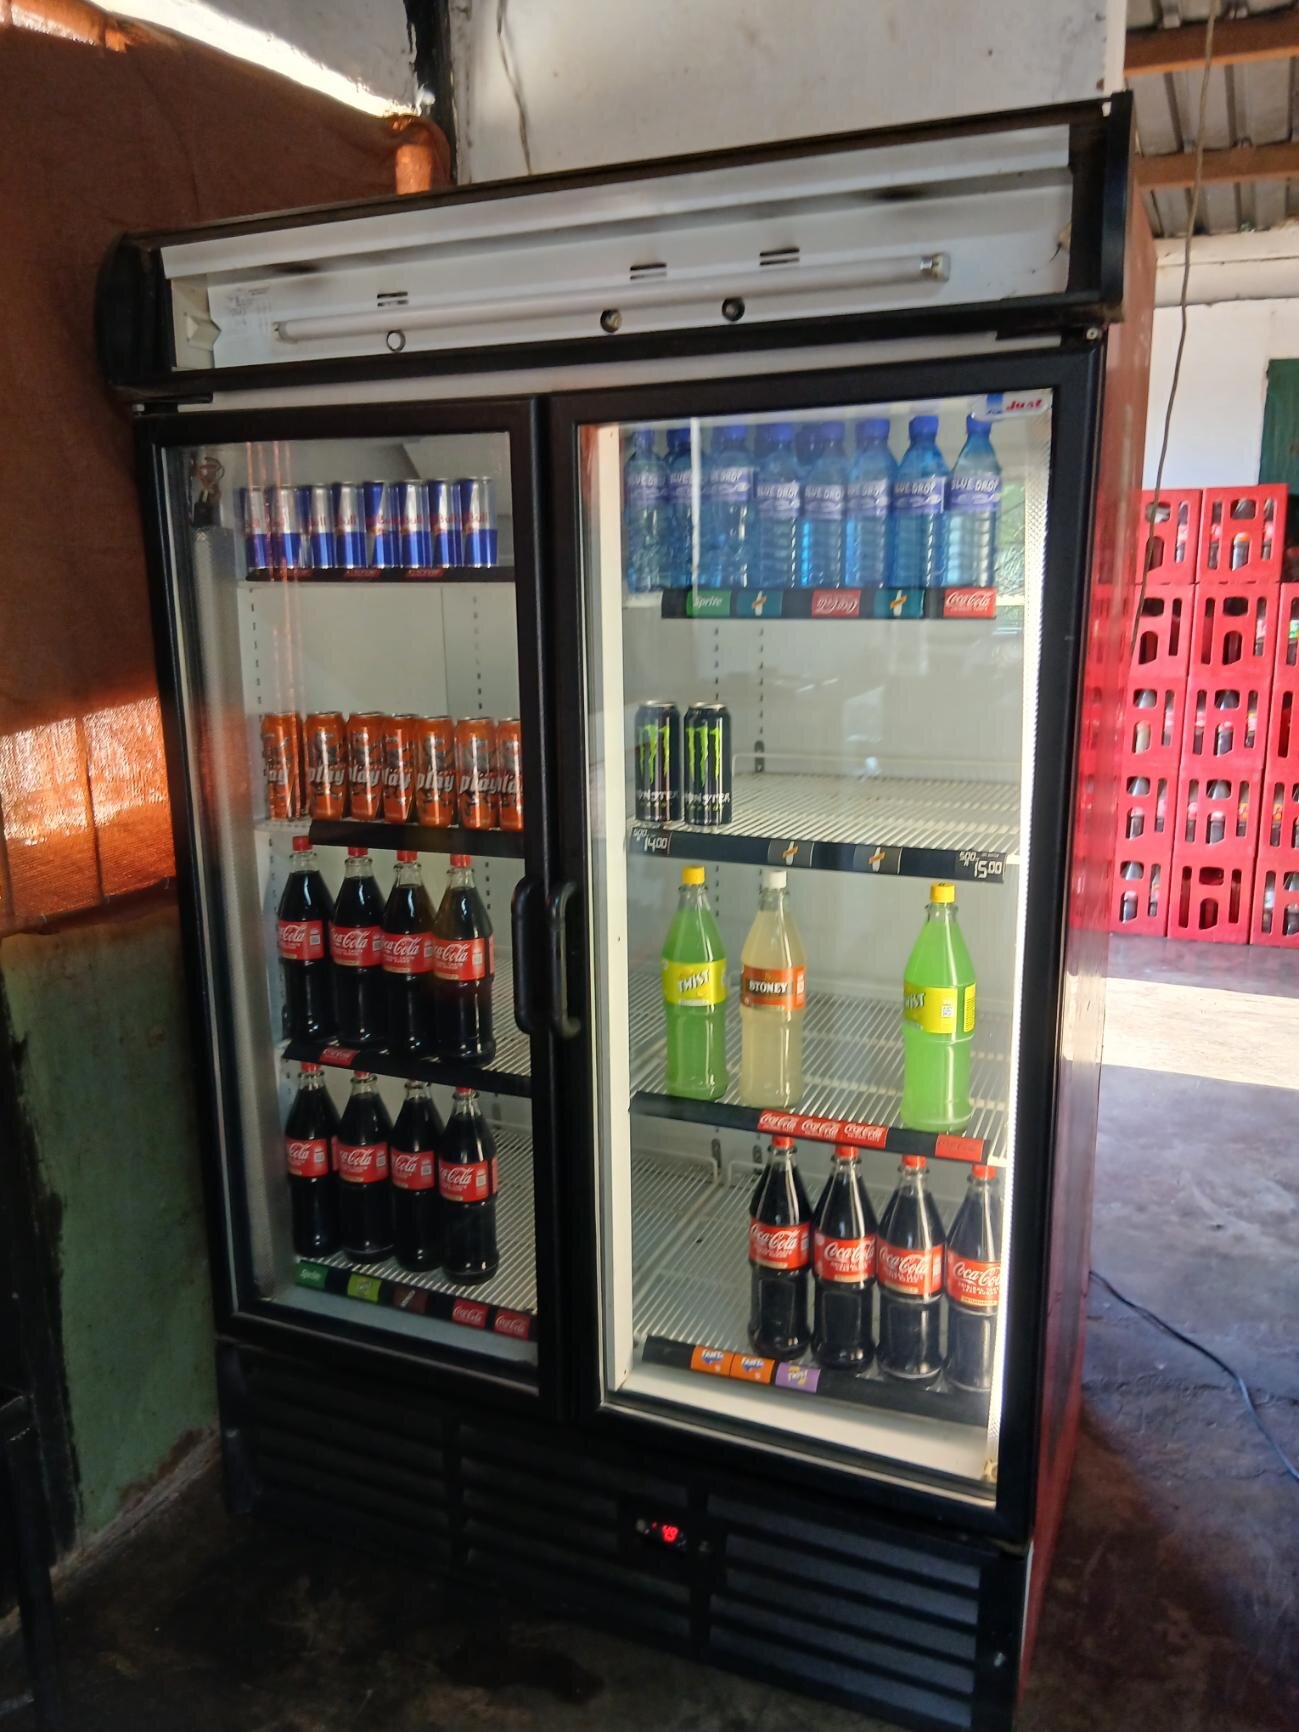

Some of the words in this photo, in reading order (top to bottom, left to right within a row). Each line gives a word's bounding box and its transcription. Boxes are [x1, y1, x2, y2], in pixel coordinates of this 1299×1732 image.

[678, 968, 710, 992] TWIST
[749, 979, 788, 994] STONEY
[751, 1222, 801, 1252] Coca-Cola
[880, 1246, 930, 1276] Coca-Cola
